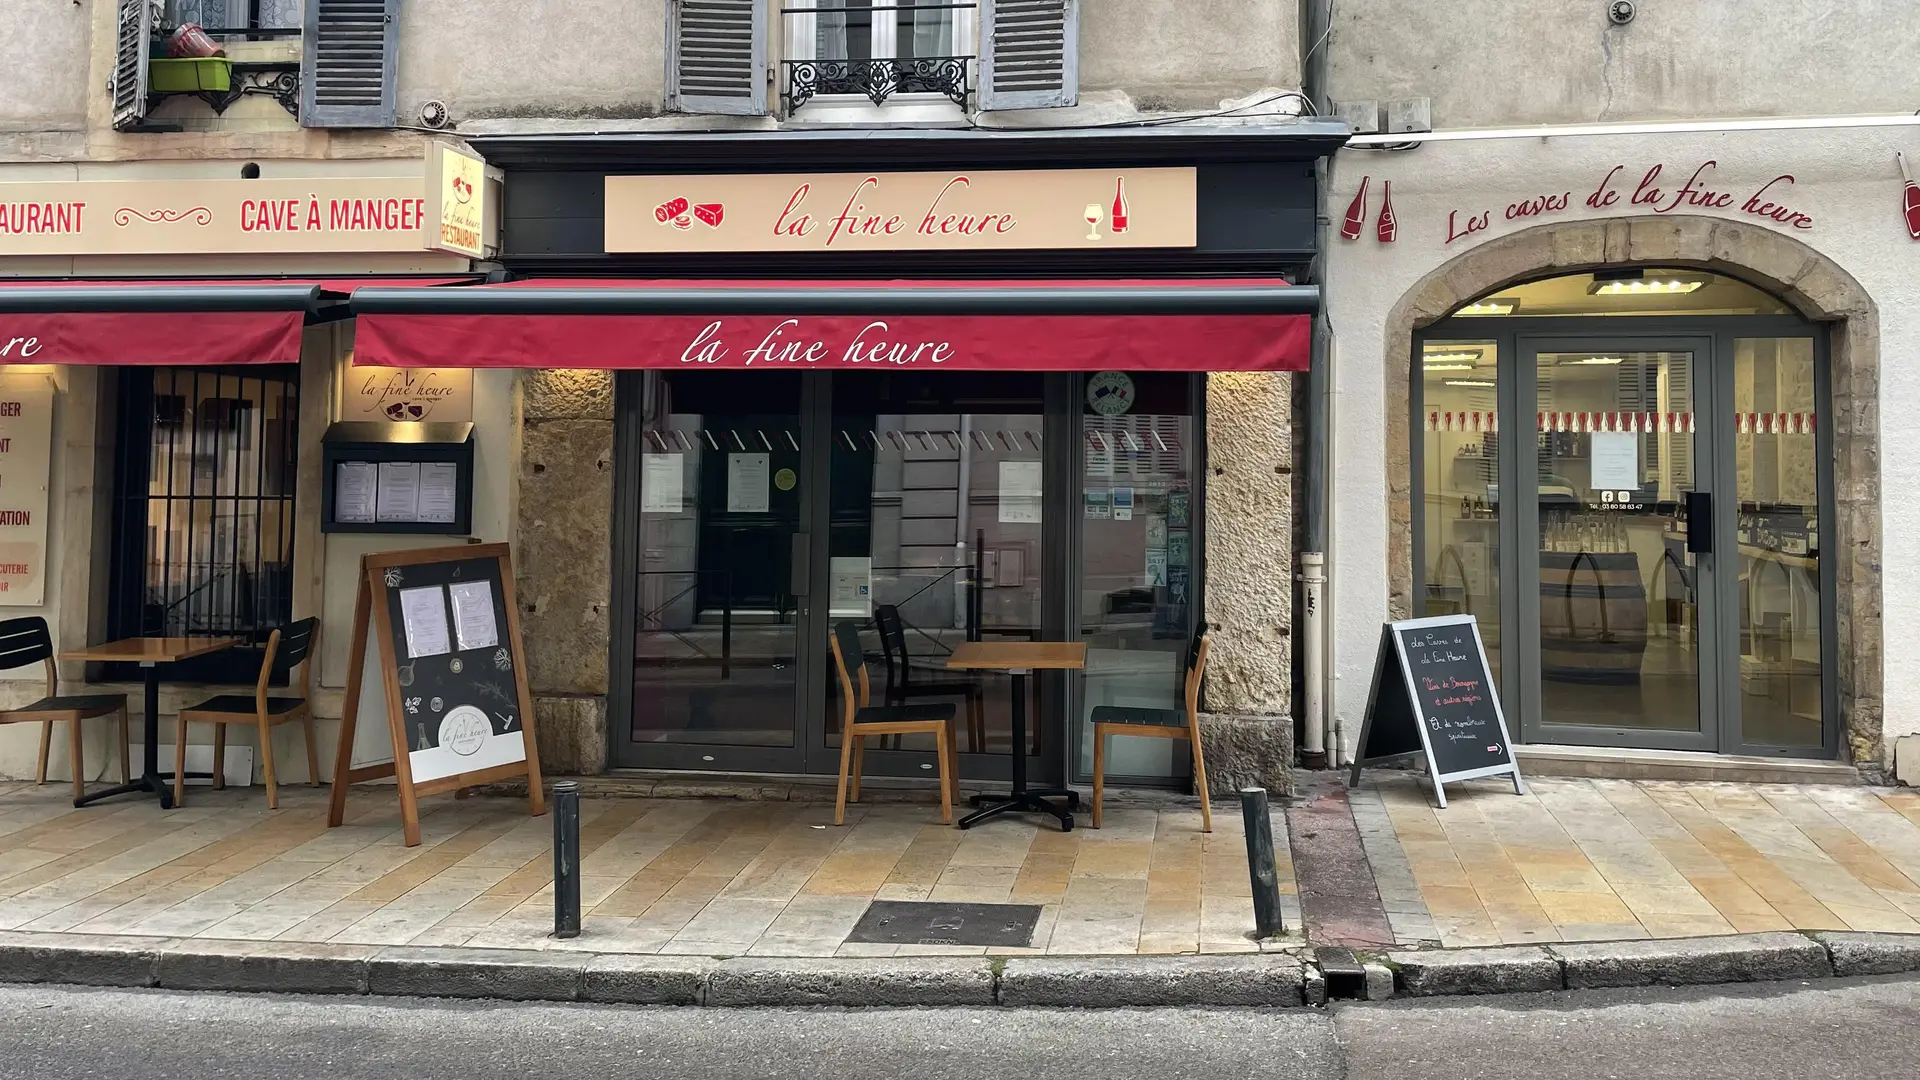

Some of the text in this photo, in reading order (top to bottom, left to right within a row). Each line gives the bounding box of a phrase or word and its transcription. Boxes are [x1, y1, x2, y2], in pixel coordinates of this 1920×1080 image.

[773, 176, 1017, 247] la fine heure
[1445, 160, 1813, 244] Les caves de la fine heure
[240, 199, 300, 232] CAVE
[306, 193, 322, 232] À
[441, 223, 481, 250] RESTAURANT
[0, 337, 43, 357] re
[681, 318, 955, 366] la fine heure
[360, 372, 455, 412] la fine heure
[1091, 396, 1130, 414] RELANCE
[1453, 635, 1463, 644] de
[1432, 650, 1447, 663] Fine
[1447, 650, 1468, 662] Heure
[1442, 679, 1450, 689] de
[1434, 696, 1442, 706] et
[1444, 718, 1453, 728] de
[1454, 715, 1486, 728] nombreux
